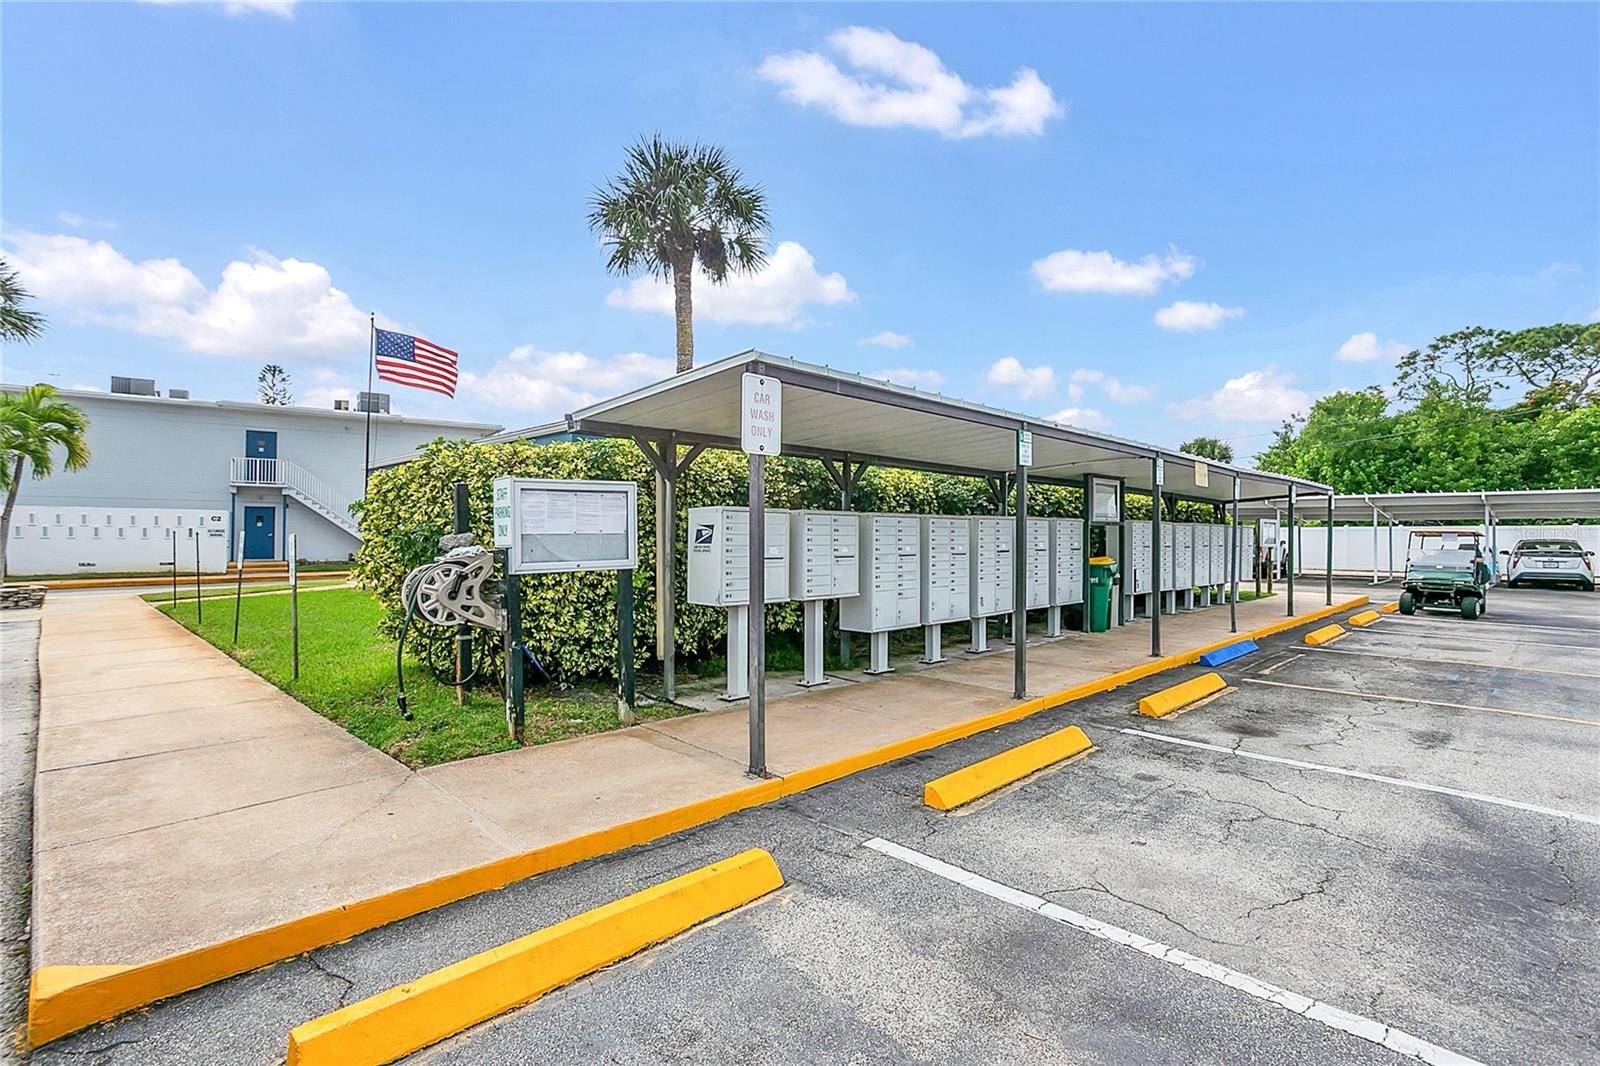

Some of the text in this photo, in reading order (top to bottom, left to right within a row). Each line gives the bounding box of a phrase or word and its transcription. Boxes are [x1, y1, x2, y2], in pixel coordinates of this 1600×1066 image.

[754, 392, 771, 405] CAR
[750, 408, 775, 422] WASH
[751, 425, 773, 438] ONLY
